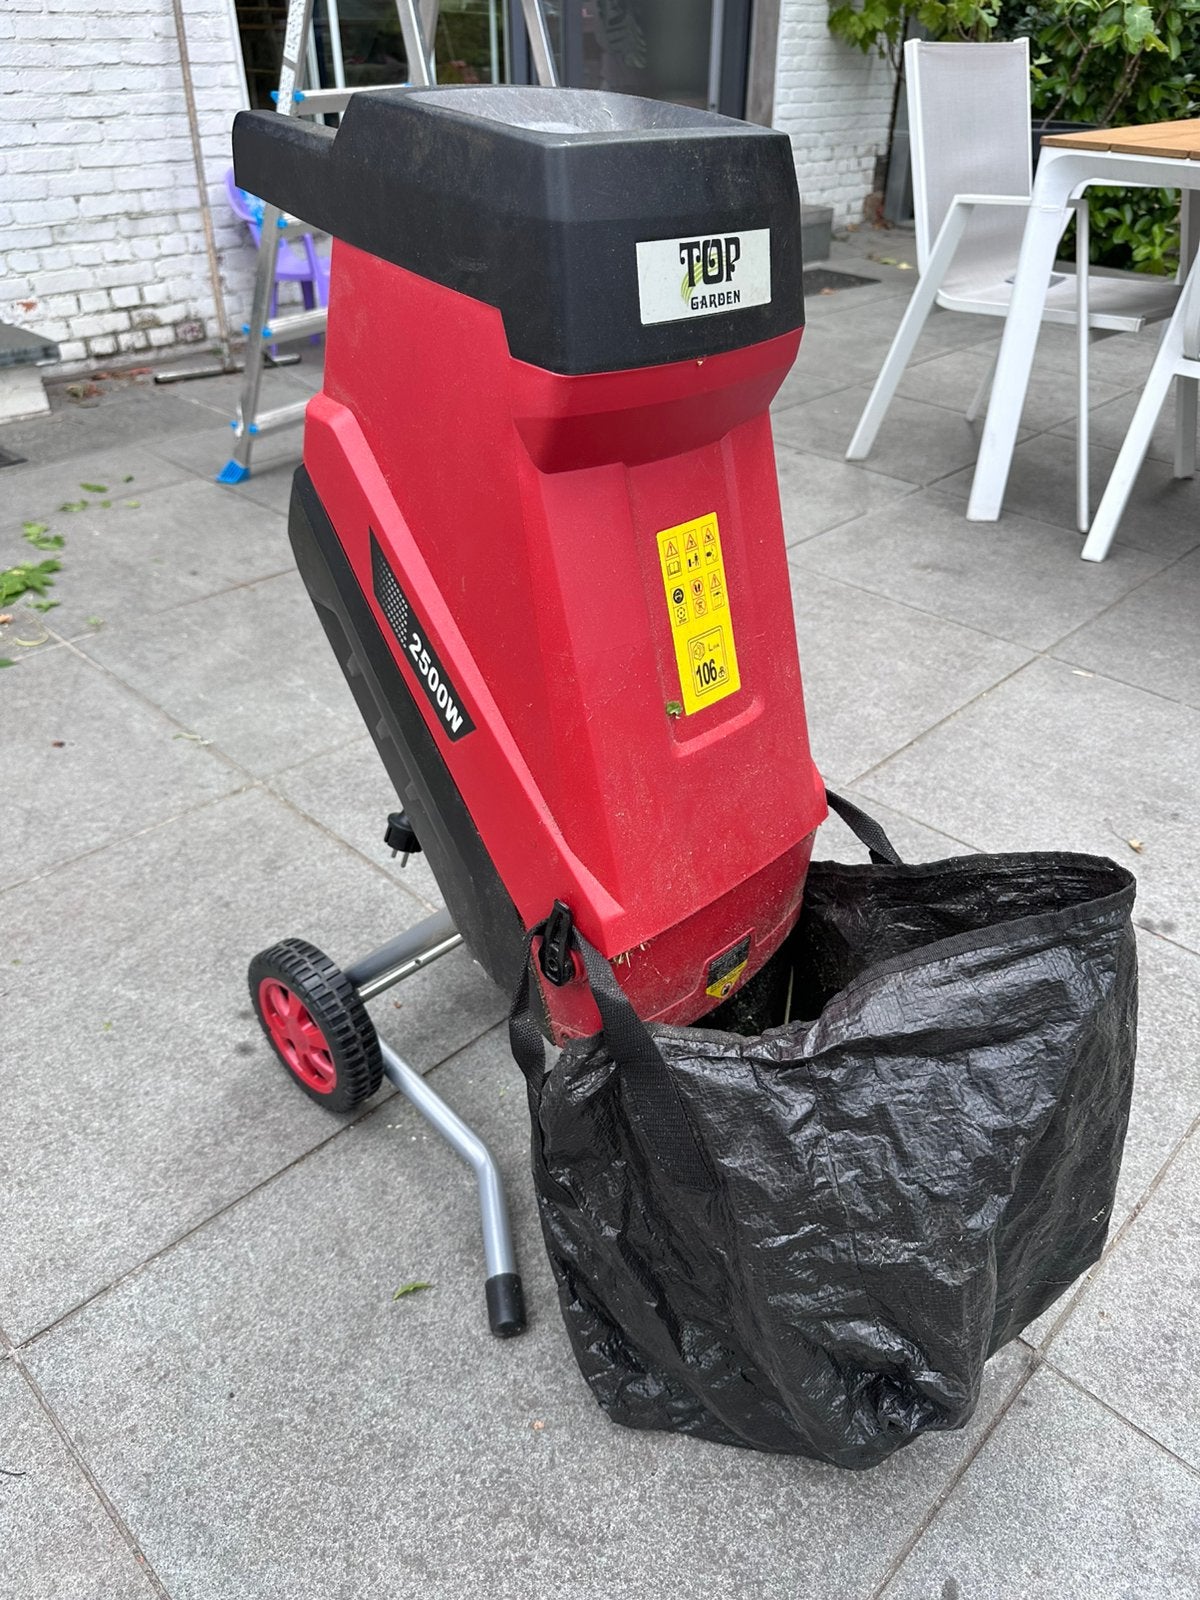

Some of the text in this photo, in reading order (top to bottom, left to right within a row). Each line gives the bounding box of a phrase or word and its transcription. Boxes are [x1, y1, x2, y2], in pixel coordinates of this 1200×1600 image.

[679, 236, 741, 288] TOP
[690, 290, 741, 310] GARDEN
[408, 632, 464, 734] 2500W
[696, 658, 718, 687] 106
